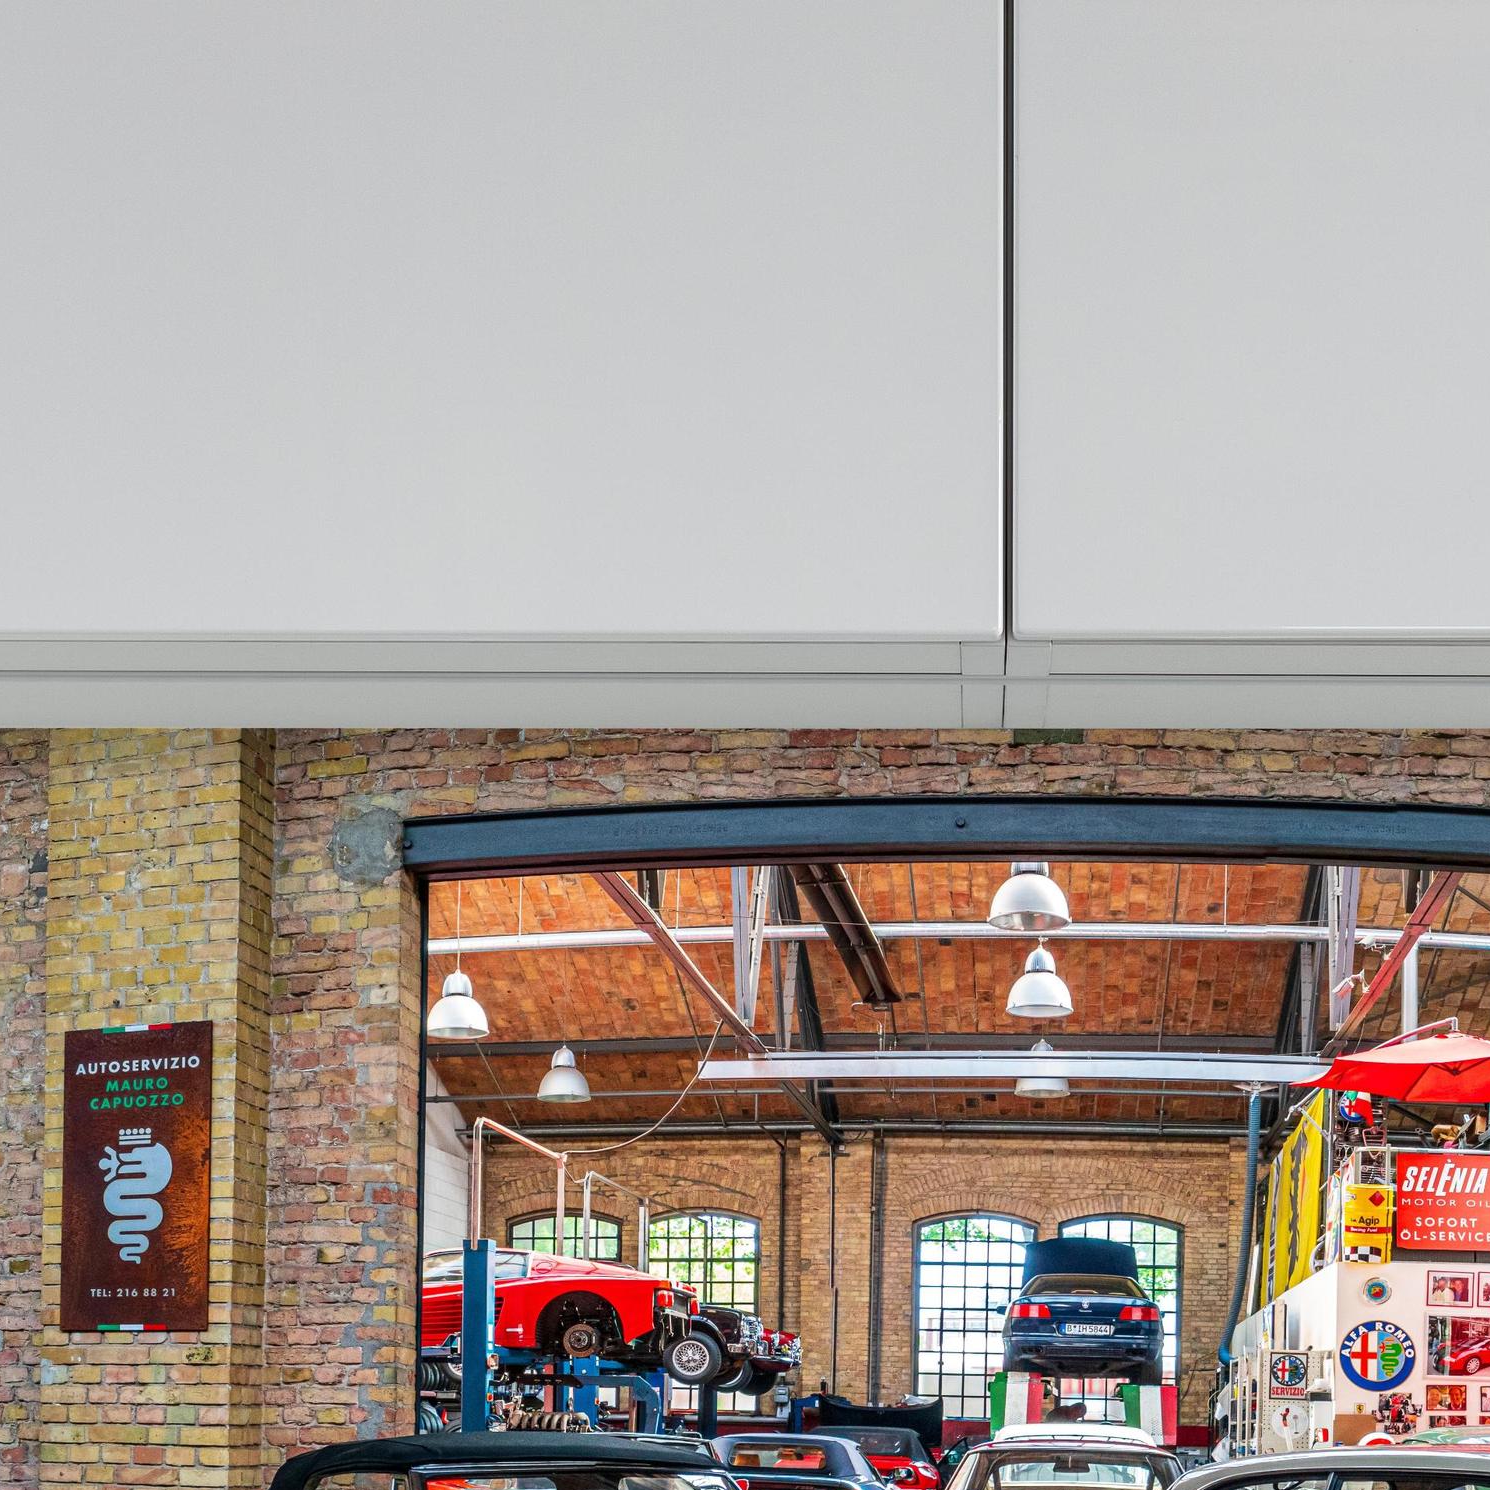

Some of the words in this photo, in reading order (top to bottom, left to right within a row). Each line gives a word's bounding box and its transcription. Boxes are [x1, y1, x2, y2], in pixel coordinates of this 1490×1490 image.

[75, 1055, 200, 1075] AUTOSERVIZIO
[105, 1076, 169, 1092] MAURO
[89, 1093, 185, 1110] CAPUOZZO
[1401, 1198, 1457, 1207] MOTOR
[1358, 1215, 1380, 1226] Agip
[1415, 1216, 1478, 1229] SOFORT
[90, 1288, 112, 1298] TEL:
[116, 1287, 138, 1298] 216
[143, 1288, 157, 1297] 88
[162, 1287, 177, 1297] 21
[1340, 1325, 1369, 1358] ALFA
[1375, 1321, 1415, 1359] ROMEO
[1271, 1387, 1305, 1397] SERVIZIO
